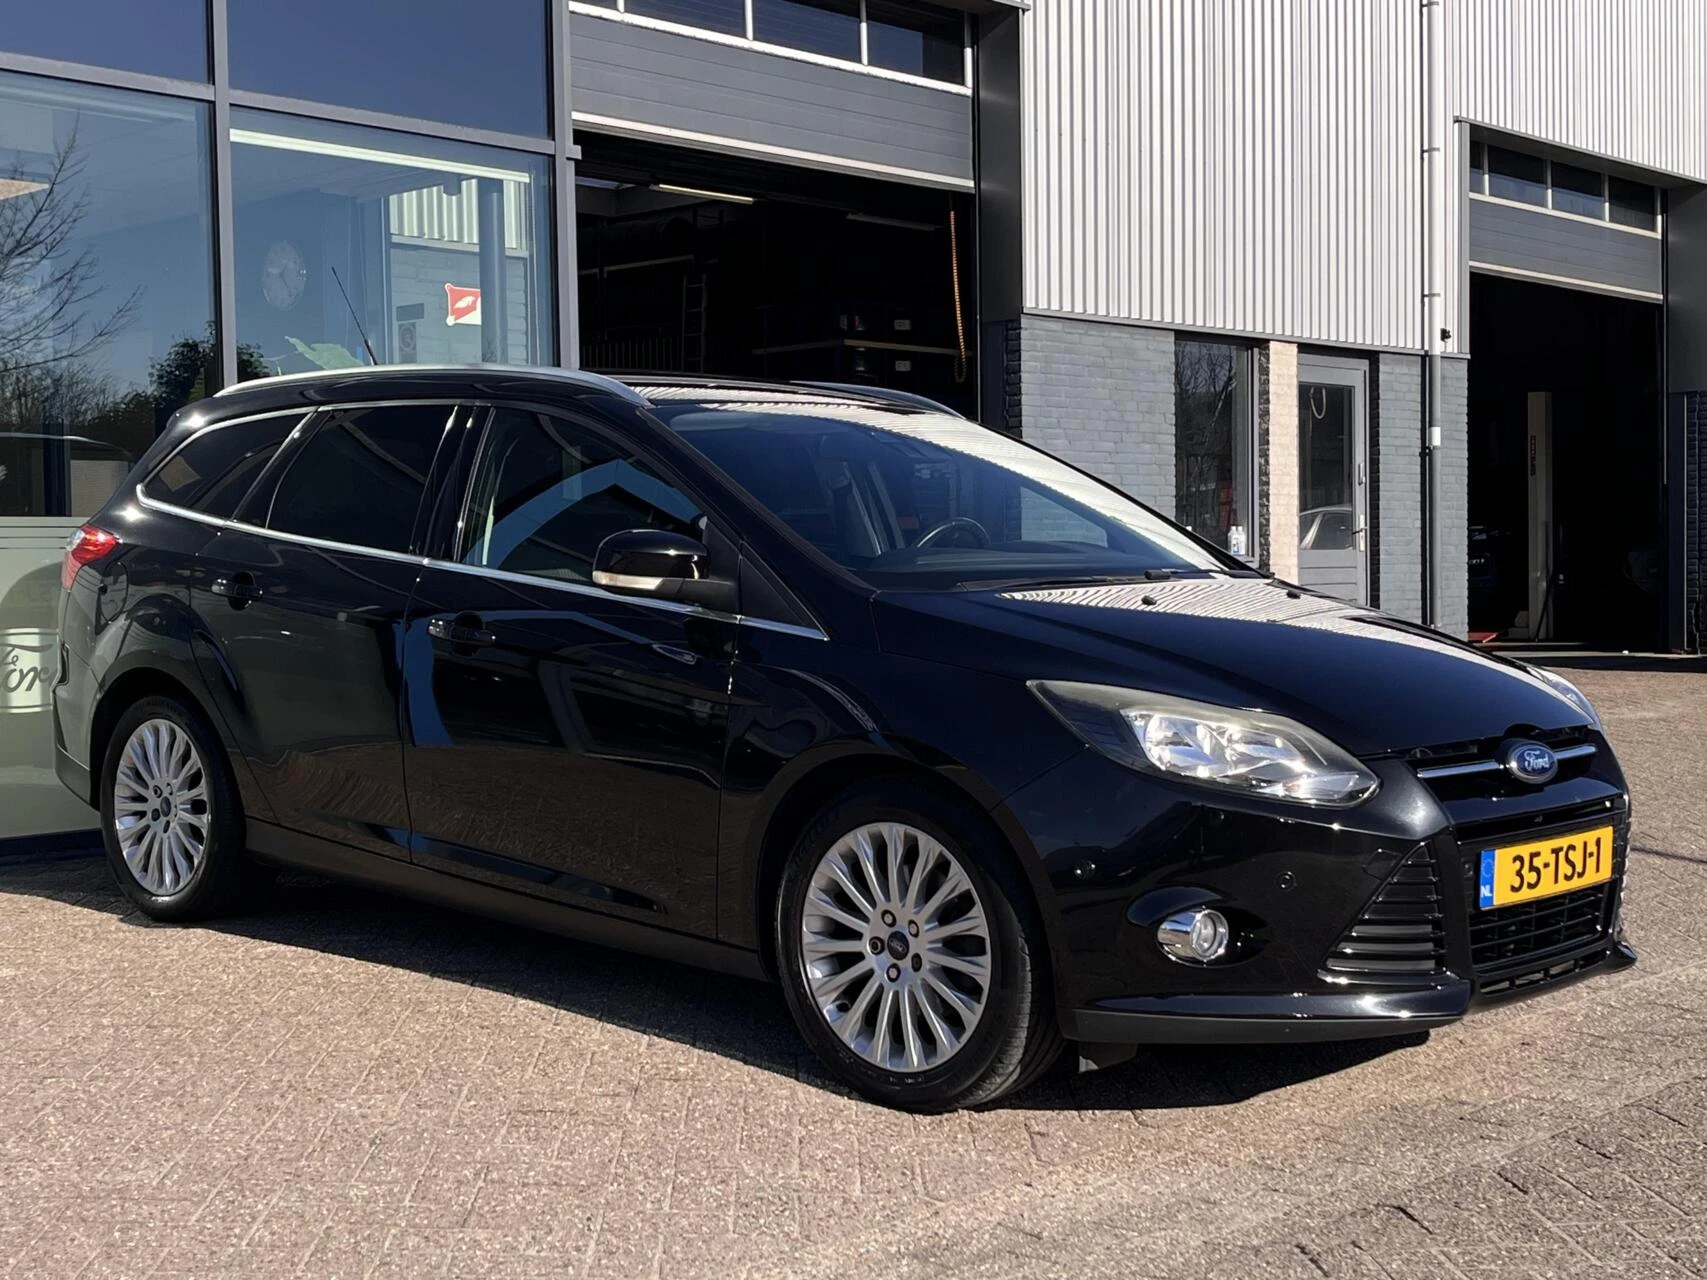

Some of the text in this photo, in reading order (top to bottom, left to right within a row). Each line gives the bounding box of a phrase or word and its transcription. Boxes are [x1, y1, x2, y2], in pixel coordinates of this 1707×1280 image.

[1523, 750, 1550, 771] Ford
[1510, 837, 1601, 893] 35-TSJ-1
[1480, 885, 1492, 898] NL
